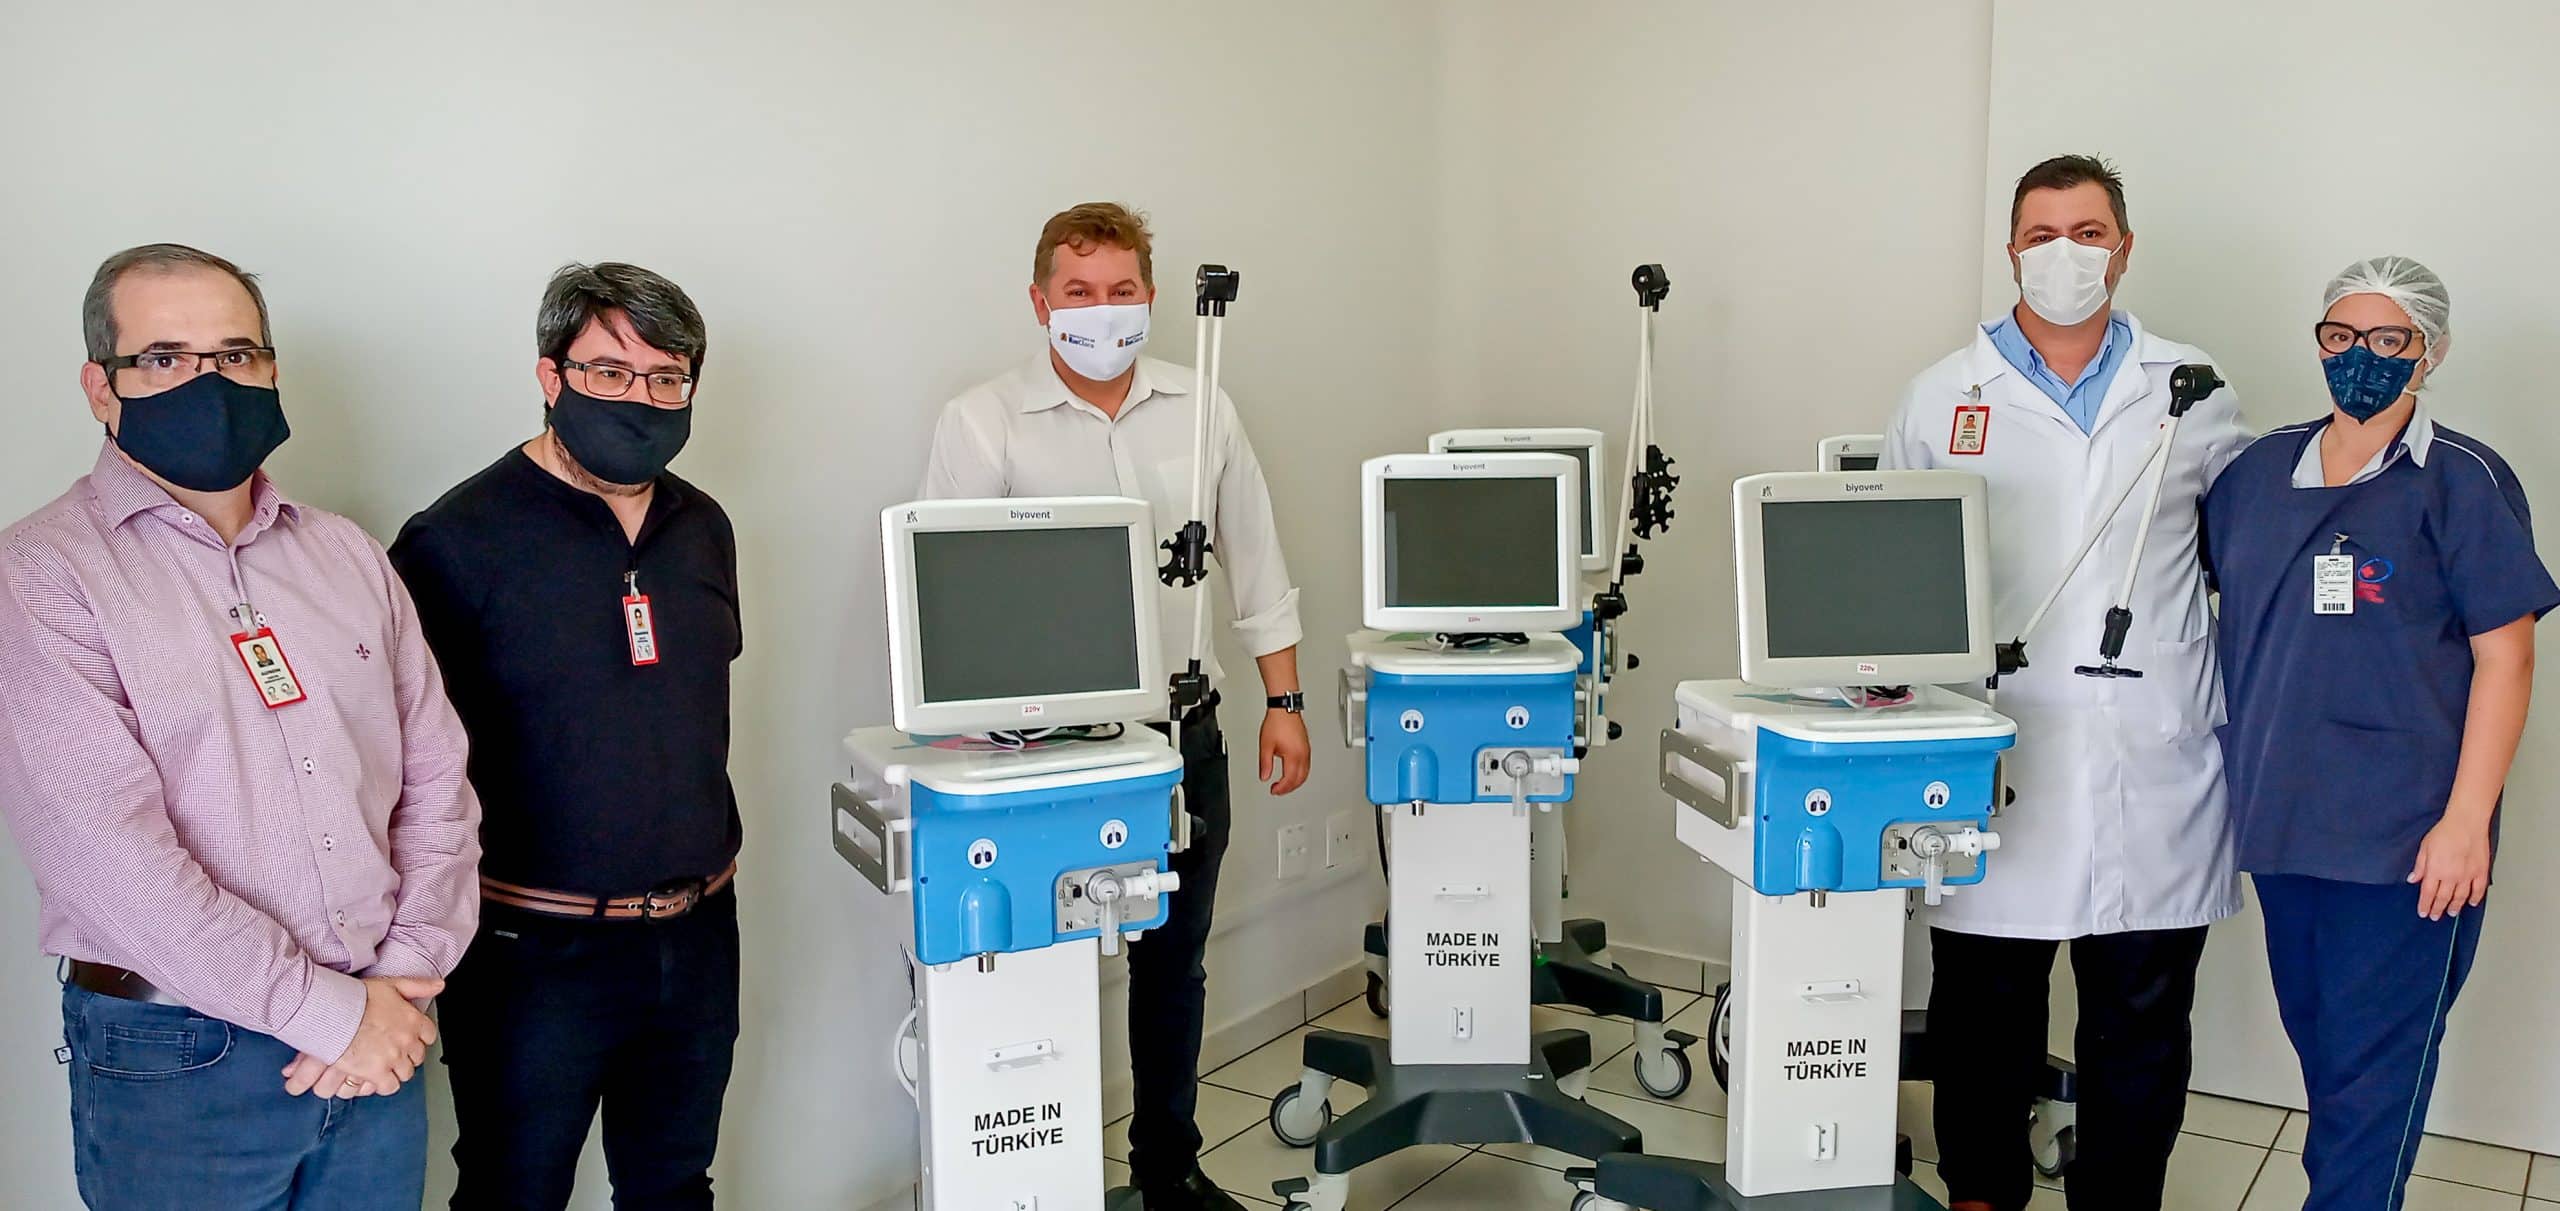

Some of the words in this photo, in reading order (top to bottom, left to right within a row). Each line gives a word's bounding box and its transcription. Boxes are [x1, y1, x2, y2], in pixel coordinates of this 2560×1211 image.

[1452, 462, 1486, 471] biyovent
[1845, 482, 1884, 492] biyovent
[1010, 510, 1051, 520] biyovent
[1484, 785, 1491, 793] N
[1890, 864, 1898, 872] N
[1065, 920, 1073, 930] N
[1426, 932, 1477, 946] MADE
[1482, 932, 1499, 946] IN
[1424, 949, 1500, 967] TÜRKİYE
[1787, 1039, 1843, 1057] MADE
[1847, 1038, 1867, 1055] IN
[1783, 1059, 1867, 1081] TÜRKİYE
[974, 1106, 1036, 1132] MADE
[1041, 1101, 1062, 1121] IN
[971, 1127, 1064, 1157] TÜRKİYE
